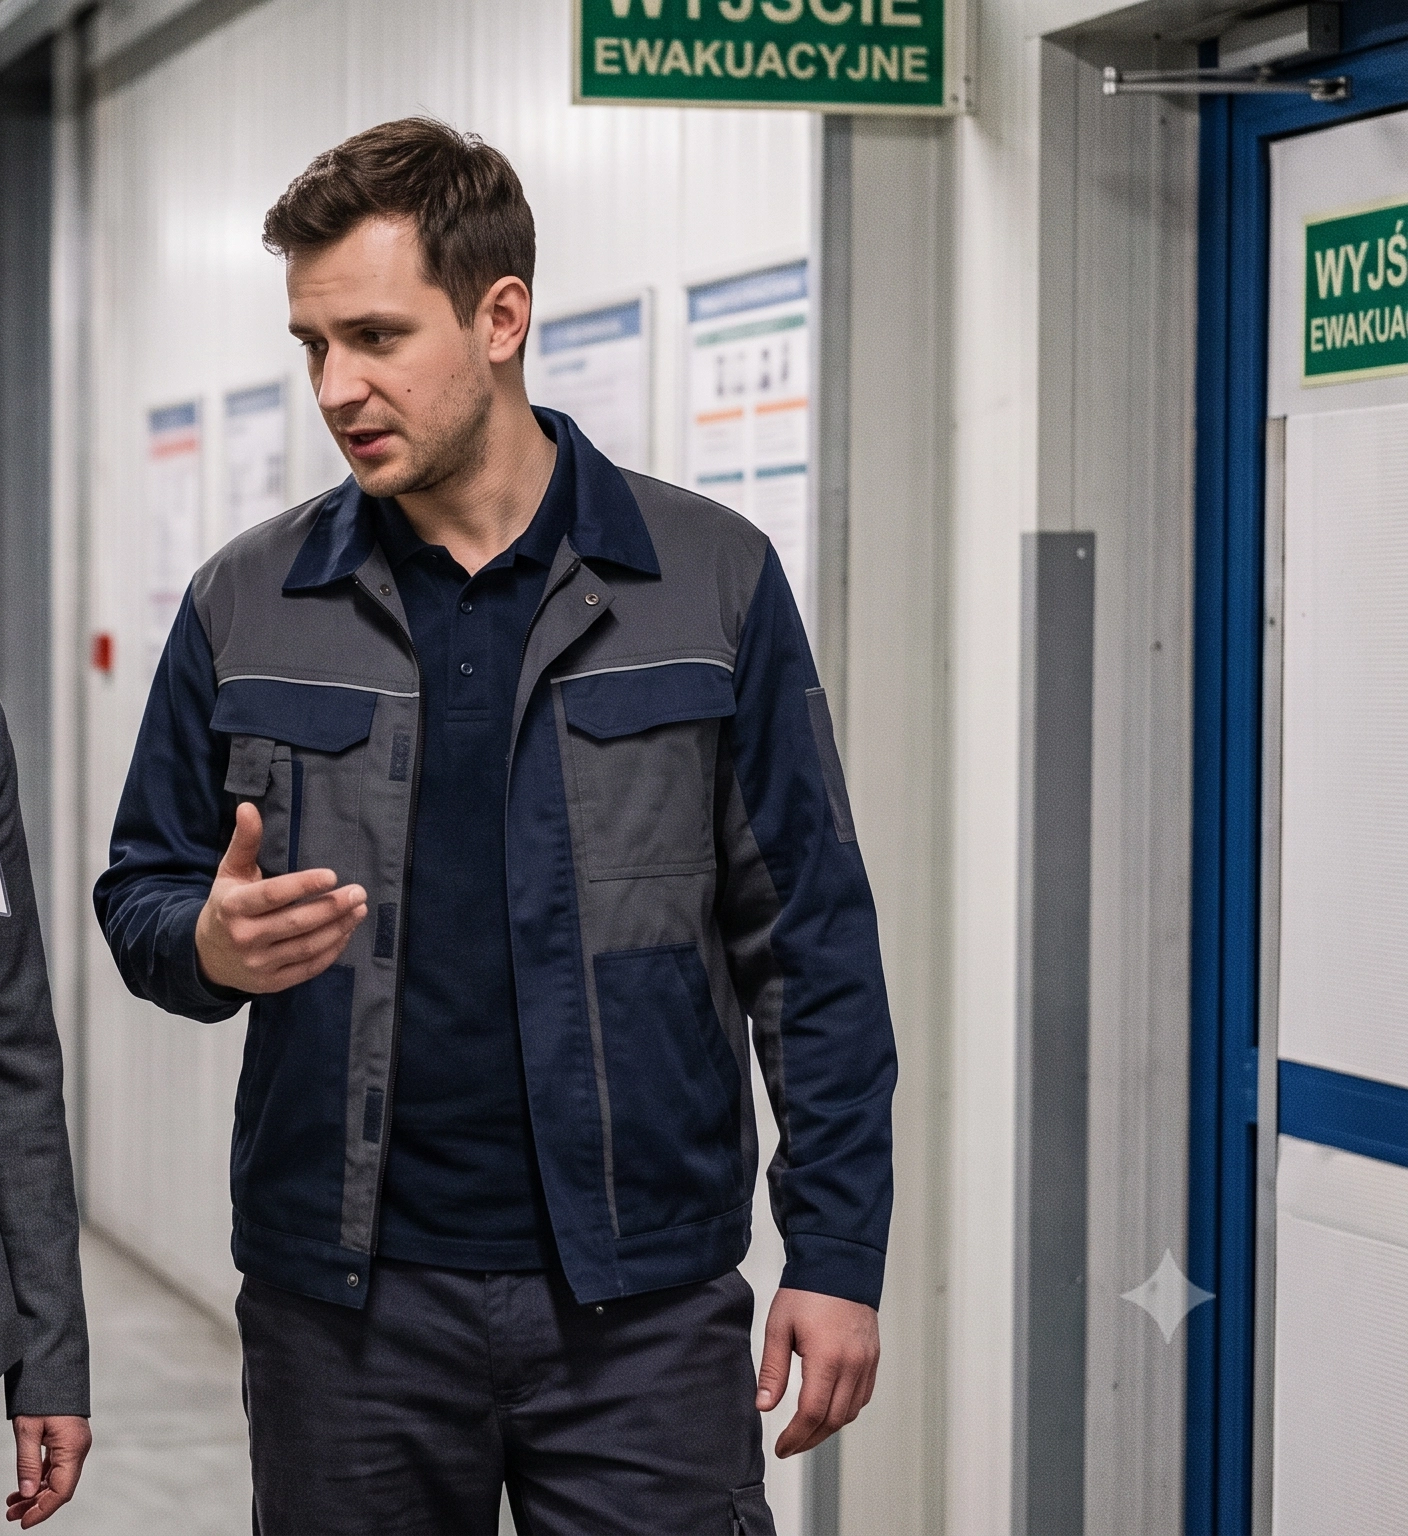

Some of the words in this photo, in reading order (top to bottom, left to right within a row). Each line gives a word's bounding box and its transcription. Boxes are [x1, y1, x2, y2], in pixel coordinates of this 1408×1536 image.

[594, 36, 929, 82] EWAKUACYJNE
[1315, 219, 1408, 299] WYJŚ
[1310, 304, 1408, 353] EWAKUA
